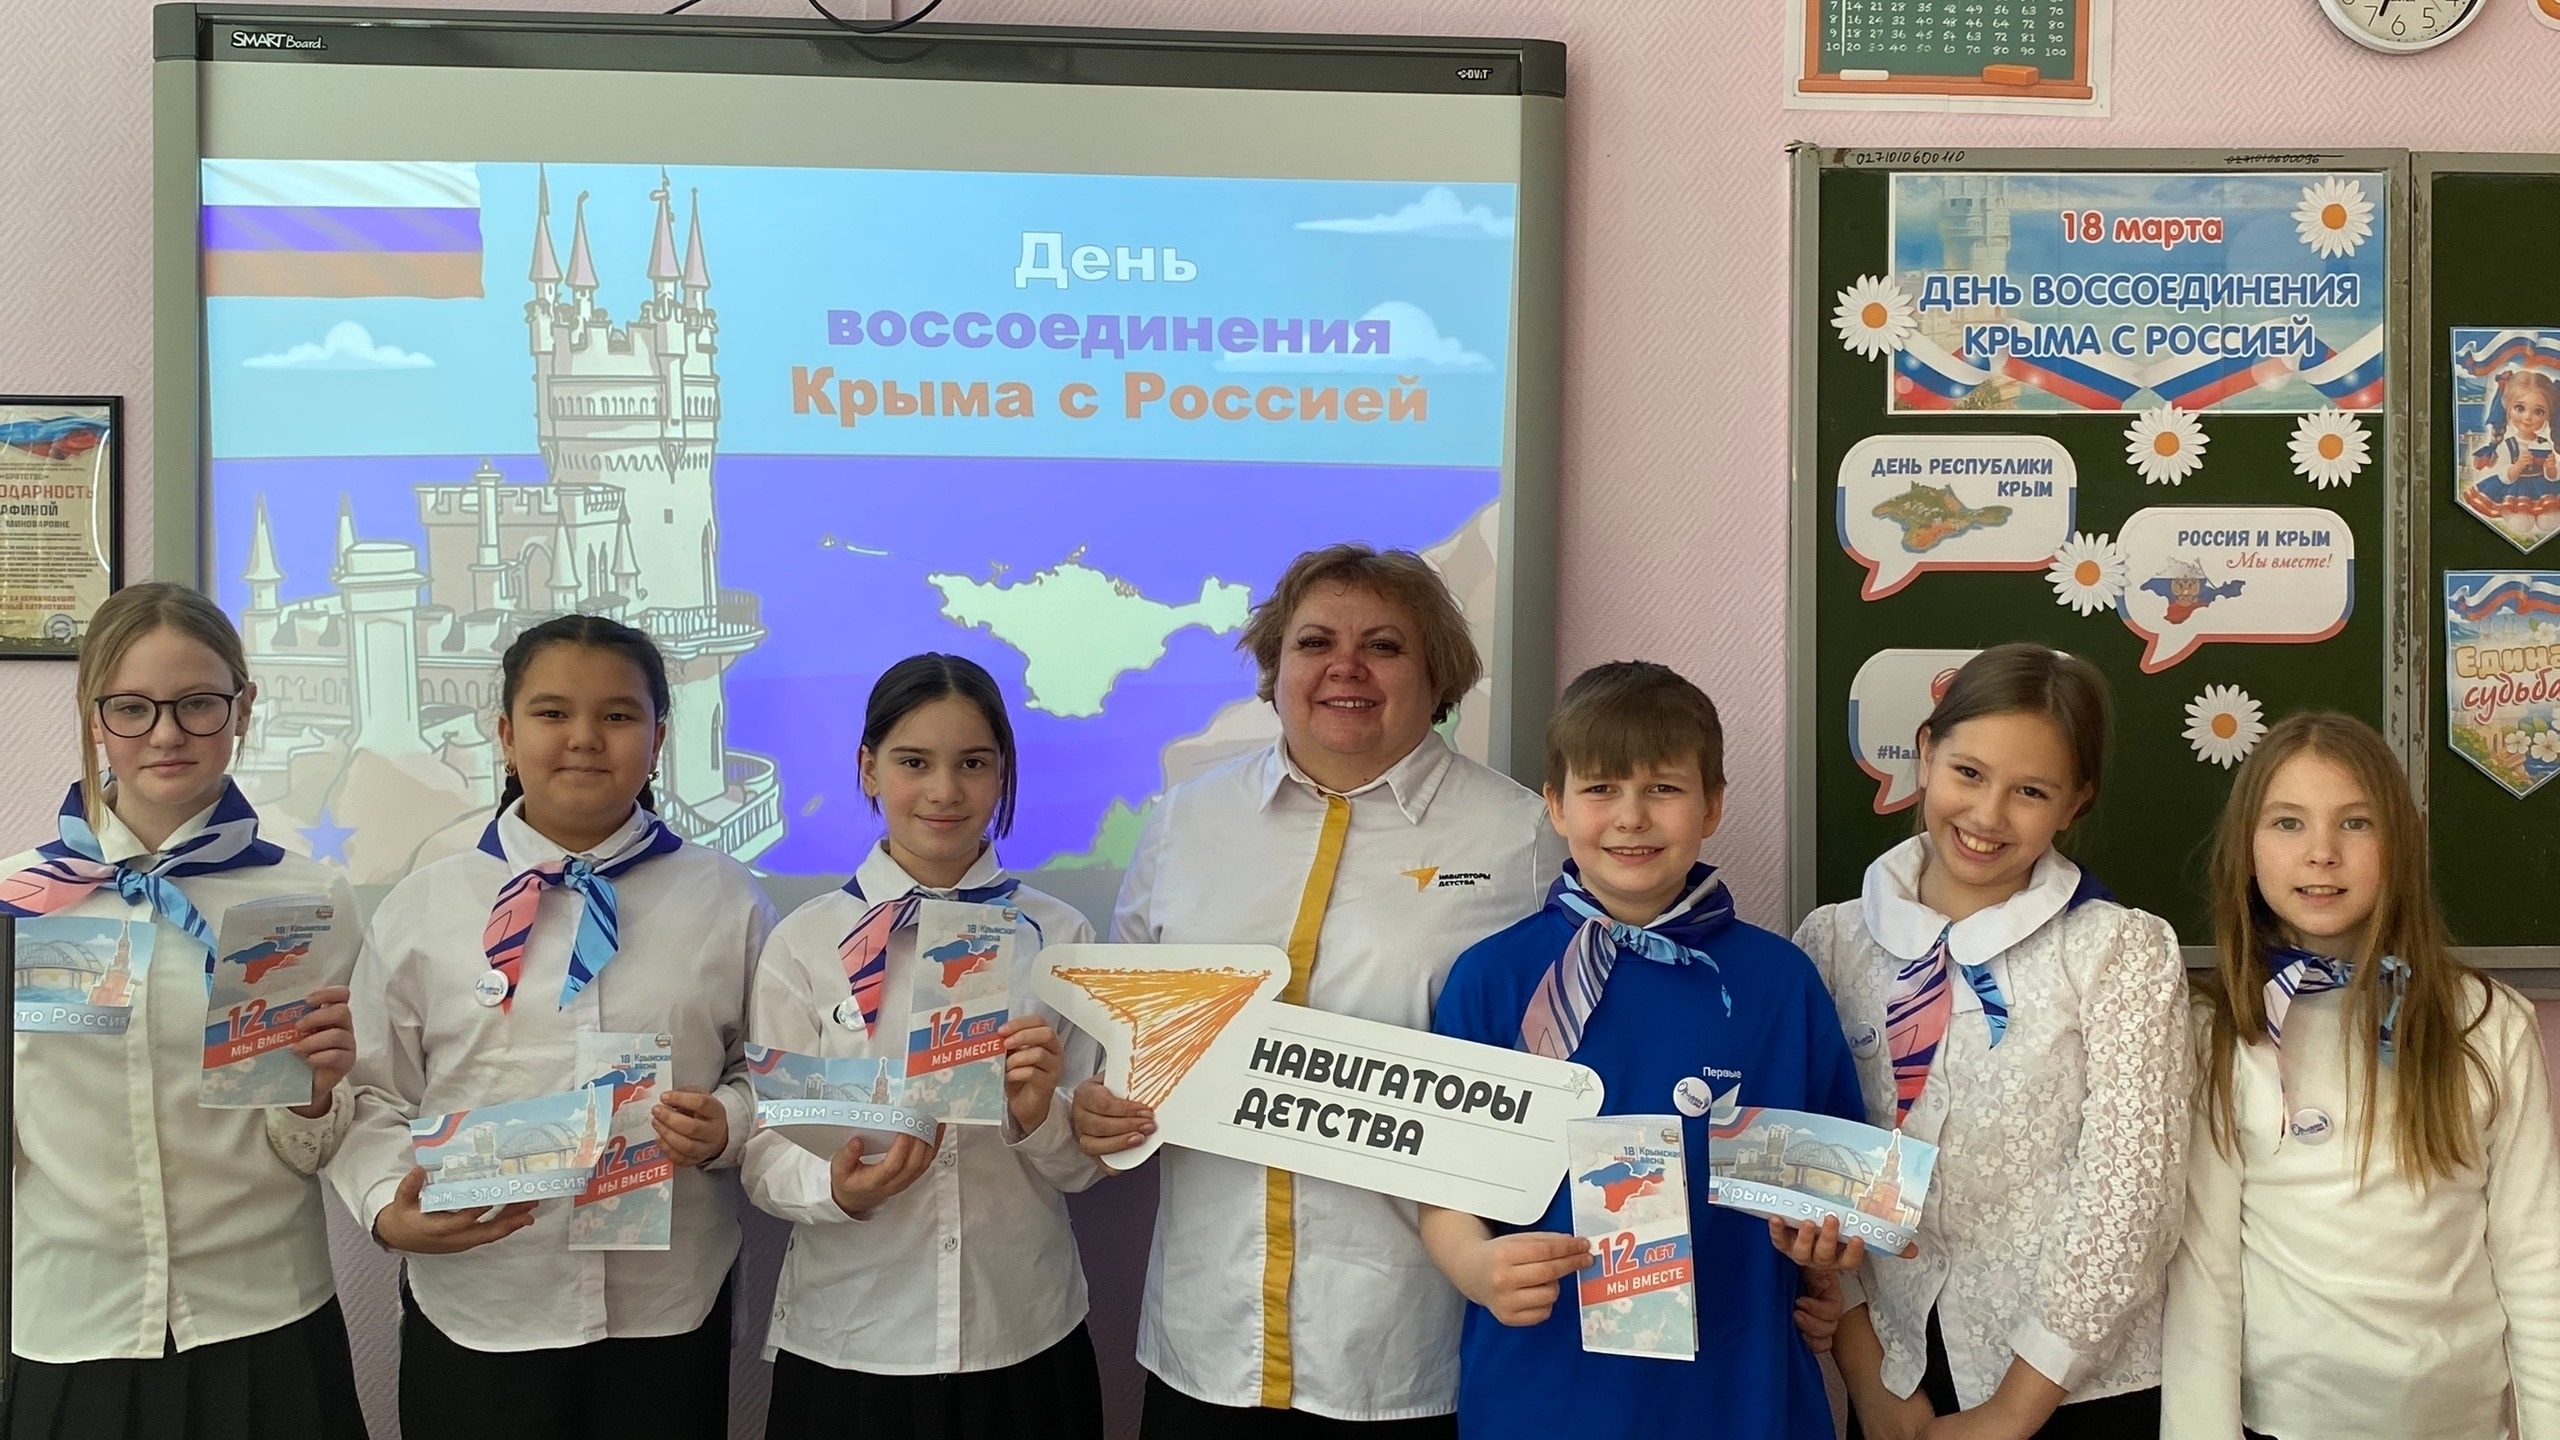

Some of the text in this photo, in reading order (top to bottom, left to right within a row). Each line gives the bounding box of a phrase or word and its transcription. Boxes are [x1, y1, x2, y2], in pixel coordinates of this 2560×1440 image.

[1830, 1, 1838, 11] 7
[1846, 1, 1863, 11] 14
[1870, 2, 1883, 11] 21
[1891, 2, 1907, 12] 28
[1917, 2, 1932, 12] 35
[1965, 5, 1983, 15] 49
[1994, 5, 2009, 15] 56
[2021, 6, 2037, 15] 63
[2049, 7, 2064, 16] 70
[2364, 5, 2378, 27] 7
[2422, 7, 2435, 28] 5
[1829, 15, 1838, 24] 8
[1847, 15, 1862, 25] 16
[1868, 15, 1884, 25] 24
[1891, 16, 1906, 25] 32
[1915, 17, 1933, 26] 40
[1942, 18, 1958, 27] 48
[1993, 19, 2010, 28] 64
[2022, 20, 2035, 29] 72
[2048, 20, 2065, 30] 80
[2391, 14, 2405, 36] 6
[232, 31, 322, 49] SMART Board
[1829, 28, 1837, 38] 9
[1846, 29, 1862, 38] 18
[1869, 29, 1884, 39] 27
[1891, 29, 1906, 39] 36
[1915, 30, 1933, 40] 45
[1966, 32, 1982, 41] 63
[1994, 32, 2008, 42] 72
[2020, 33, 2036, 42] 81
[2048, 34, 2063, 43] 90
[1826, 42, 1840, 51] 10
[1846, 42, 1861, 52] 20
[1889, 43, 1907, 53] 40
[1966, 45, 1981, 55] 70
[1993, 46, 2009, 55] 80
[2020, 46, 2036, 56] 90
[2045, 47, 2067, 56] 100
[2063, 211, 2223, 249] 18 марта
[1014, 231, 1199, 290] День
[1920, 274, 2358, 311] ДЕНЬ ВОССОЕДИНЕНИЯ
[826, 309, 1391, 360] воссоединения
[1964, 316, 2314, 356] КРЫМА С РОССИЕЙ
[790, 365, 1429, 427] Крыма с Россией
[1871, 458, 2053, 477] ДЕНЬ РЕСПУБЛИКИ
[1997, 481, 2053, 497] КРЫМ
[2178, 530, 2330, 547] РОССИЯ И КРЫМ
[2226, 552, 2333, 569] Мы вместе!
[2462, 667, 2560, 724] судьба
[1438, 872, 1491, 880] НАВИГАТОРЫ
[15, 1006, 127, 1027] то Россия
[229, 998, 267, 1042] 12
[929, 1005, 997, 1050] 12 ЛЕТ
[231, 1042, 253, 1058] МЫ
[931, 1039, 1000, 1066] МЫ ВМЕСТЕ
[1249, 1036, 1533, 1125] НАВИГАТОРЫ
[1702, 1066, 1742, 1080] Первые
[765, 1104, 827, 1122] Крым
[849, 1110, 885, 1123] это
[1234, 1087, 1425, 1156] ДЕТСТВА
[1623, 1146, 1635, 1156] 18
[471, 1186, 503, 1201] это
[508, 1177, 587, 1196] Россия
[598, 1164, 668, 1195] МЫ ВМЕСТЕ
[1718, 1180, 1777, 1206] Крым
[1598, 1231, 1677, 1278] 12 ЛЕТ
[1606, 1266, 1684, 1296] МЫ ВМЕСТЕ
